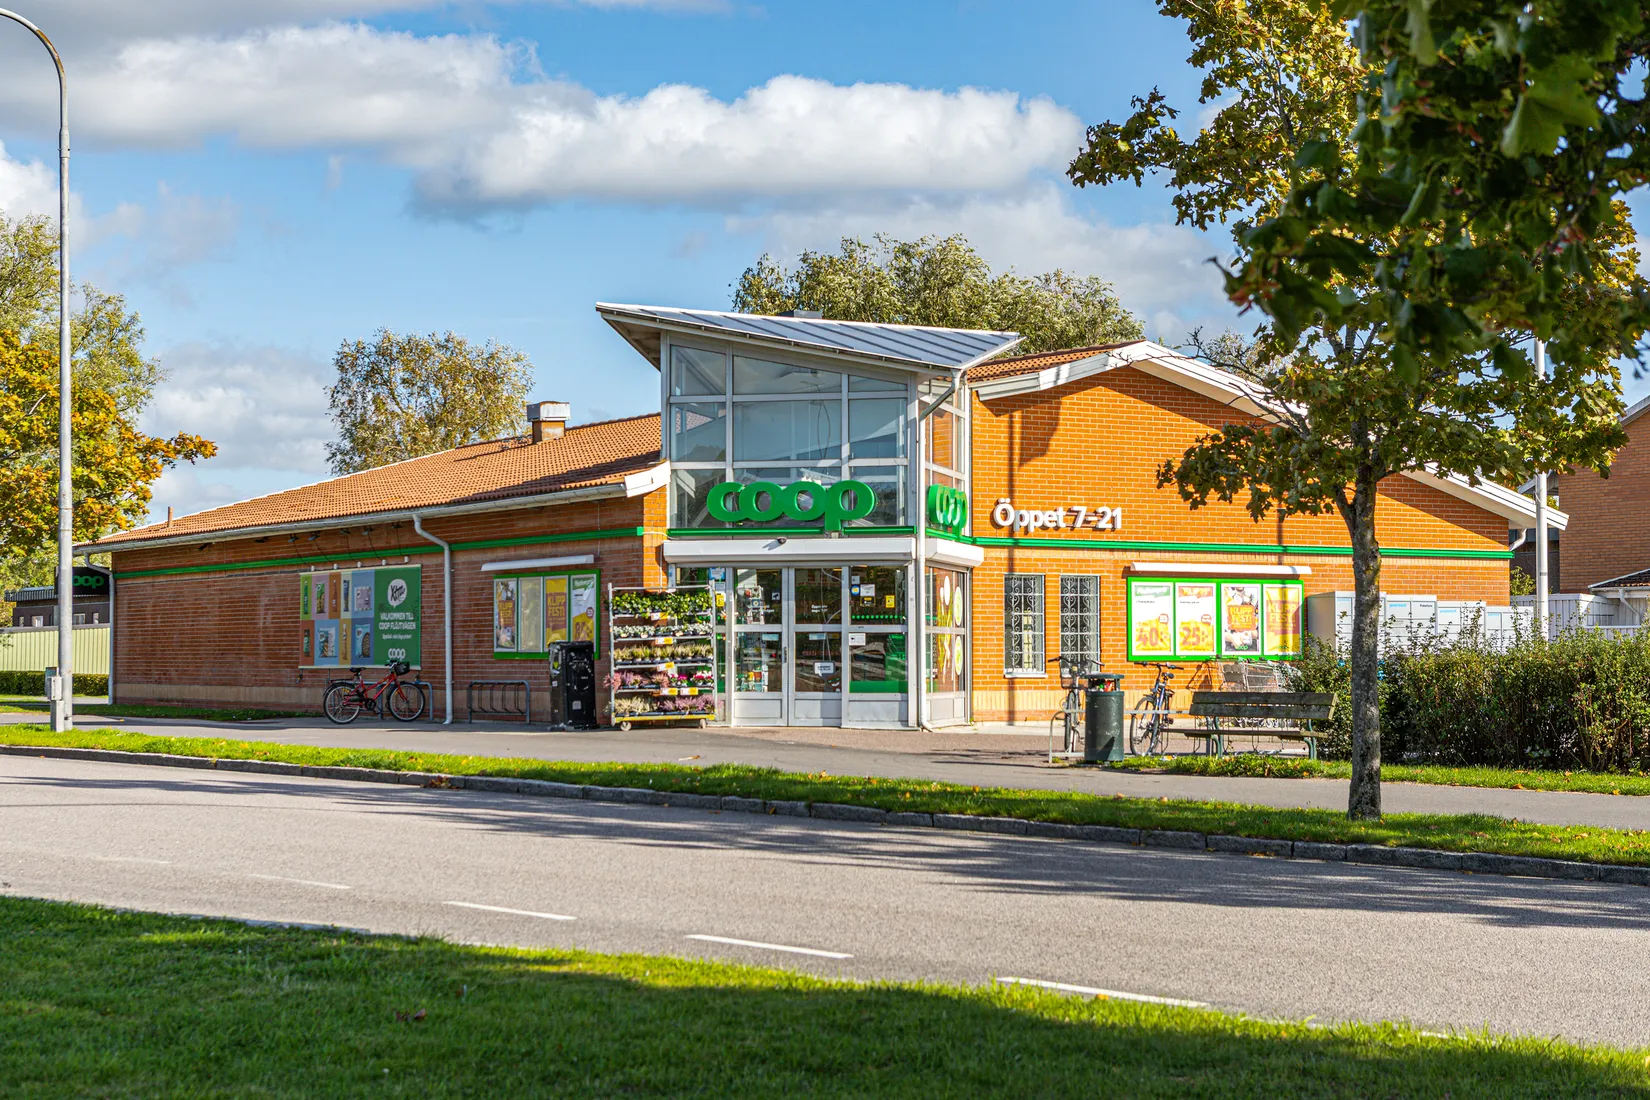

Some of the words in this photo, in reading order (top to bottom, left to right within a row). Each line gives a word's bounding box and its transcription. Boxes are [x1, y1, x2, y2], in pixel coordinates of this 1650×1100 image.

[707, 480, 876, 531] coop
[927, 484, 968, 541] coop
[993, 498, 1066, 532] Öppet
[1070, 506, 1122, 529] 7-21
[72, 575, 105, 589] oop
[388, 648, 406, 662] coop
